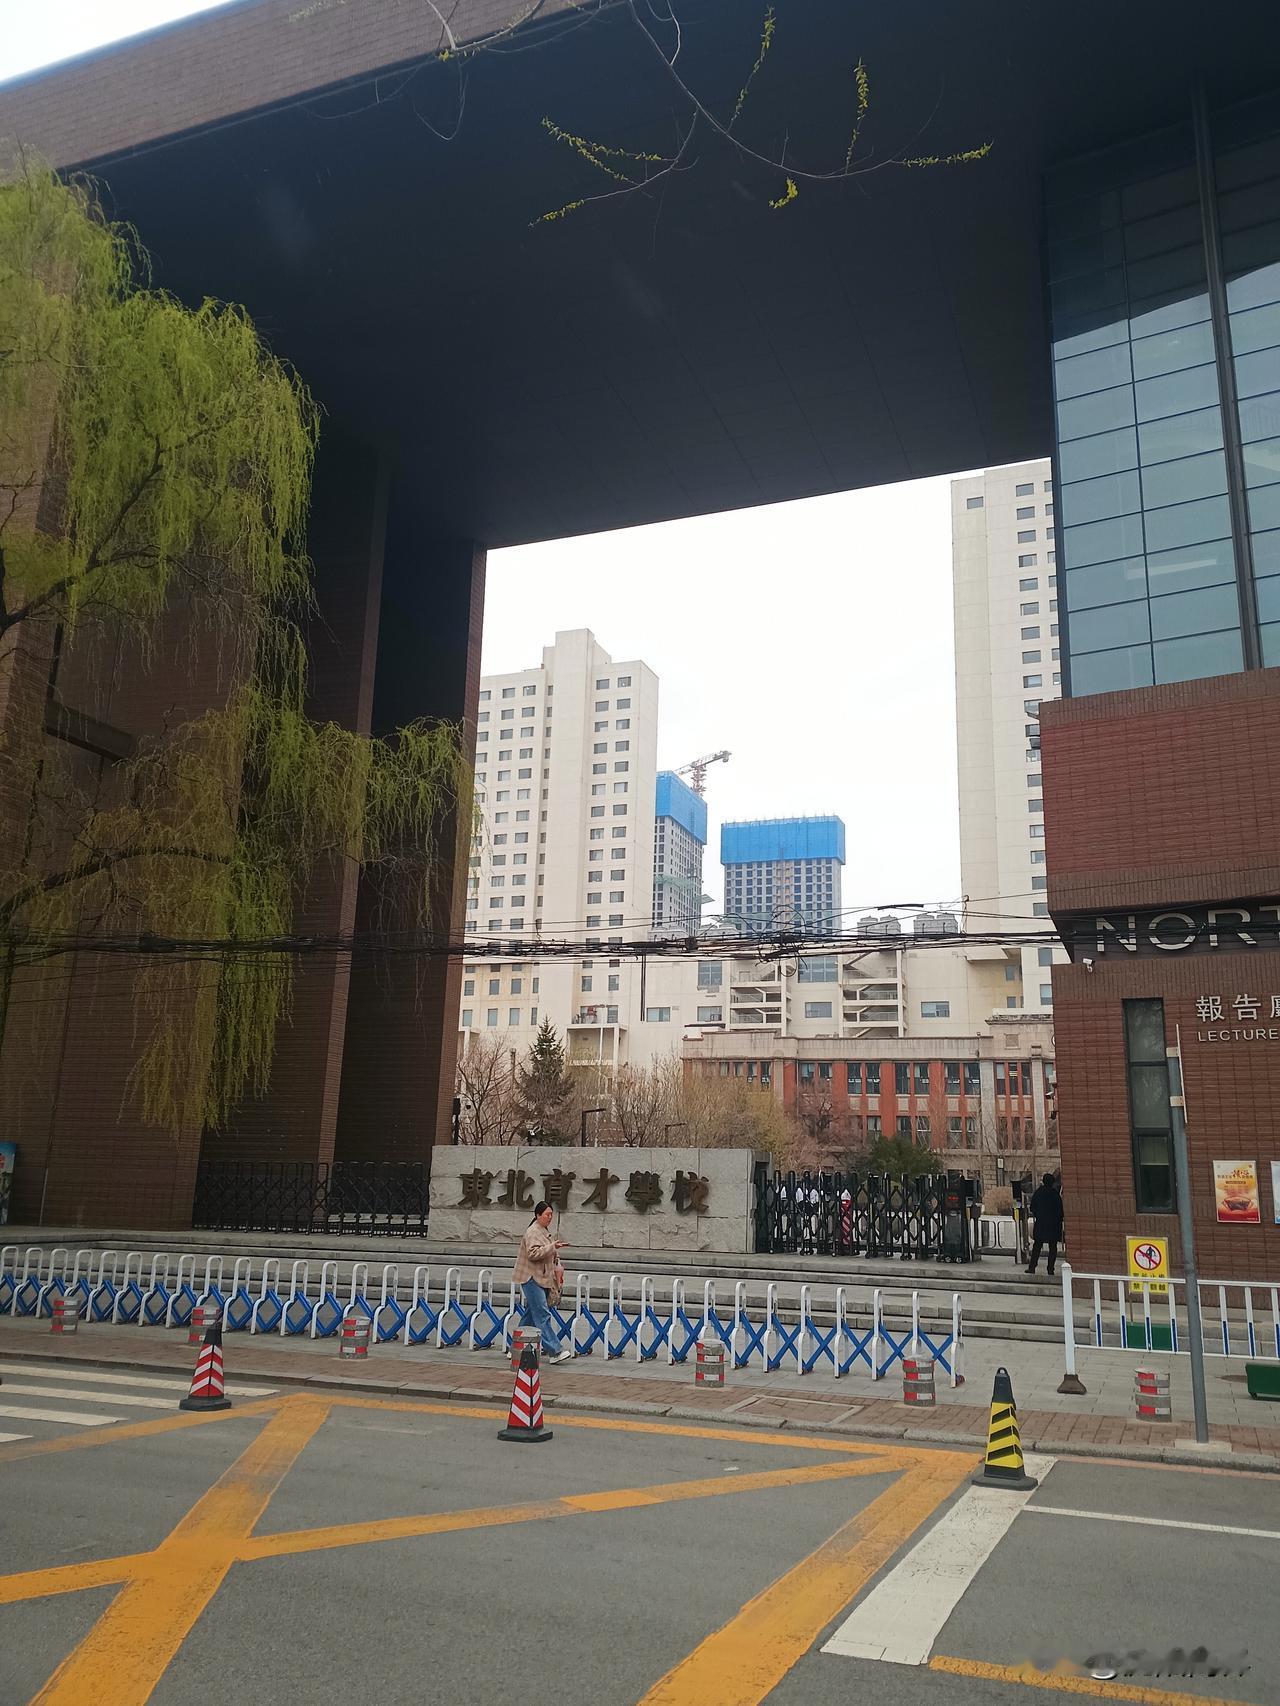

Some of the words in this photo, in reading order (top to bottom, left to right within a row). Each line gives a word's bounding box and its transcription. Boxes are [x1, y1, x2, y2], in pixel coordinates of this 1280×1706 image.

[1198, 1029, 1279, 1041] LECTURE
[458, 1167, 709, 1214] 東北育才學校
